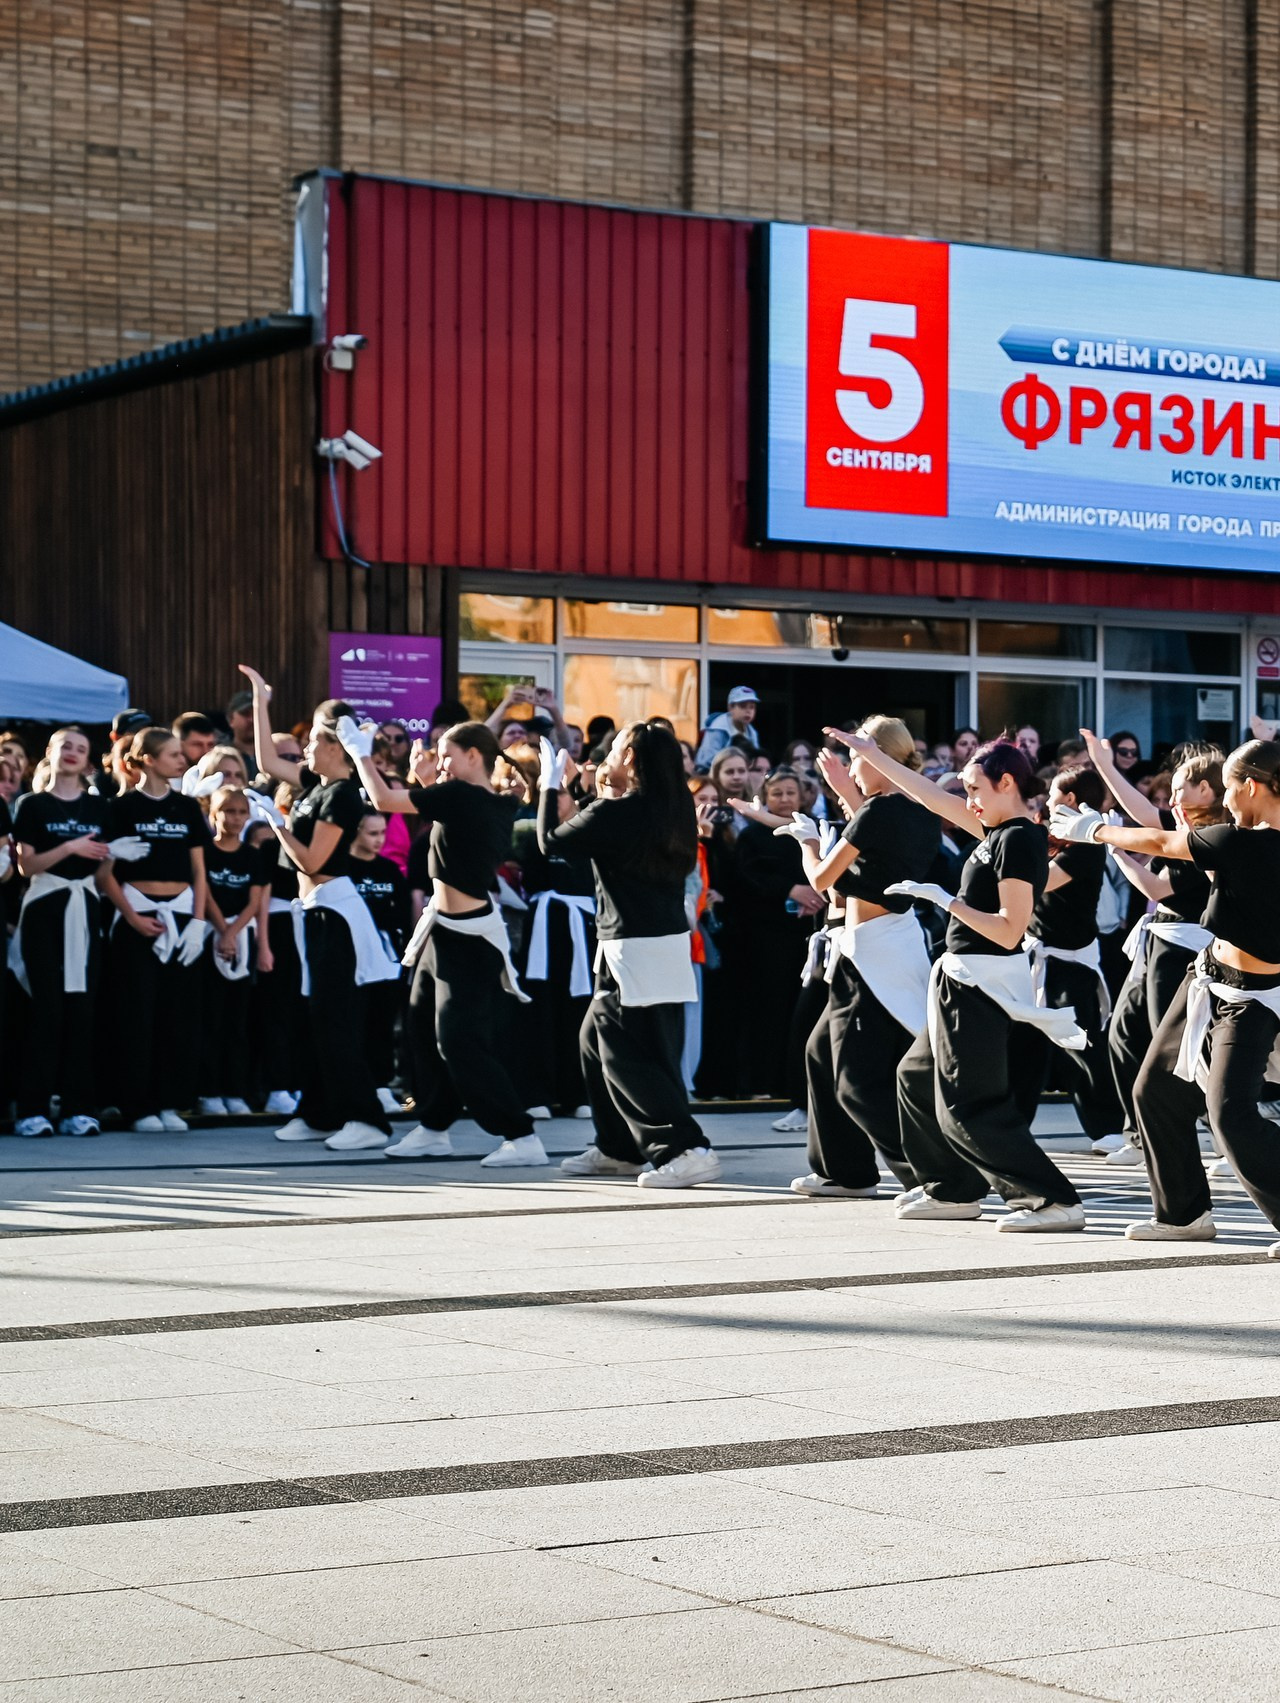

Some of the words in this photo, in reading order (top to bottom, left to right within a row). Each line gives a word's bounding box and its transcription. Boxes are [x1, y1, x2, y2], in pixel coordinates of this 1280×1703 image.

[835, 297, 925, 443] 5
[1051, 337, 1071, 361] С
[1075, 338, 1151, 370] ДНЁМ
[1156, 350, 1267, 381] ГОРОДА!
[825, 446, 933, 475] СЕНТЯБРЯ
[1172, 470, 1227, 488] ИСТОК
[994, 501, 1171, 531] АДМИНИСТРАЦИЯ
[1177, 514, 1253, 537] ГОРОДА
